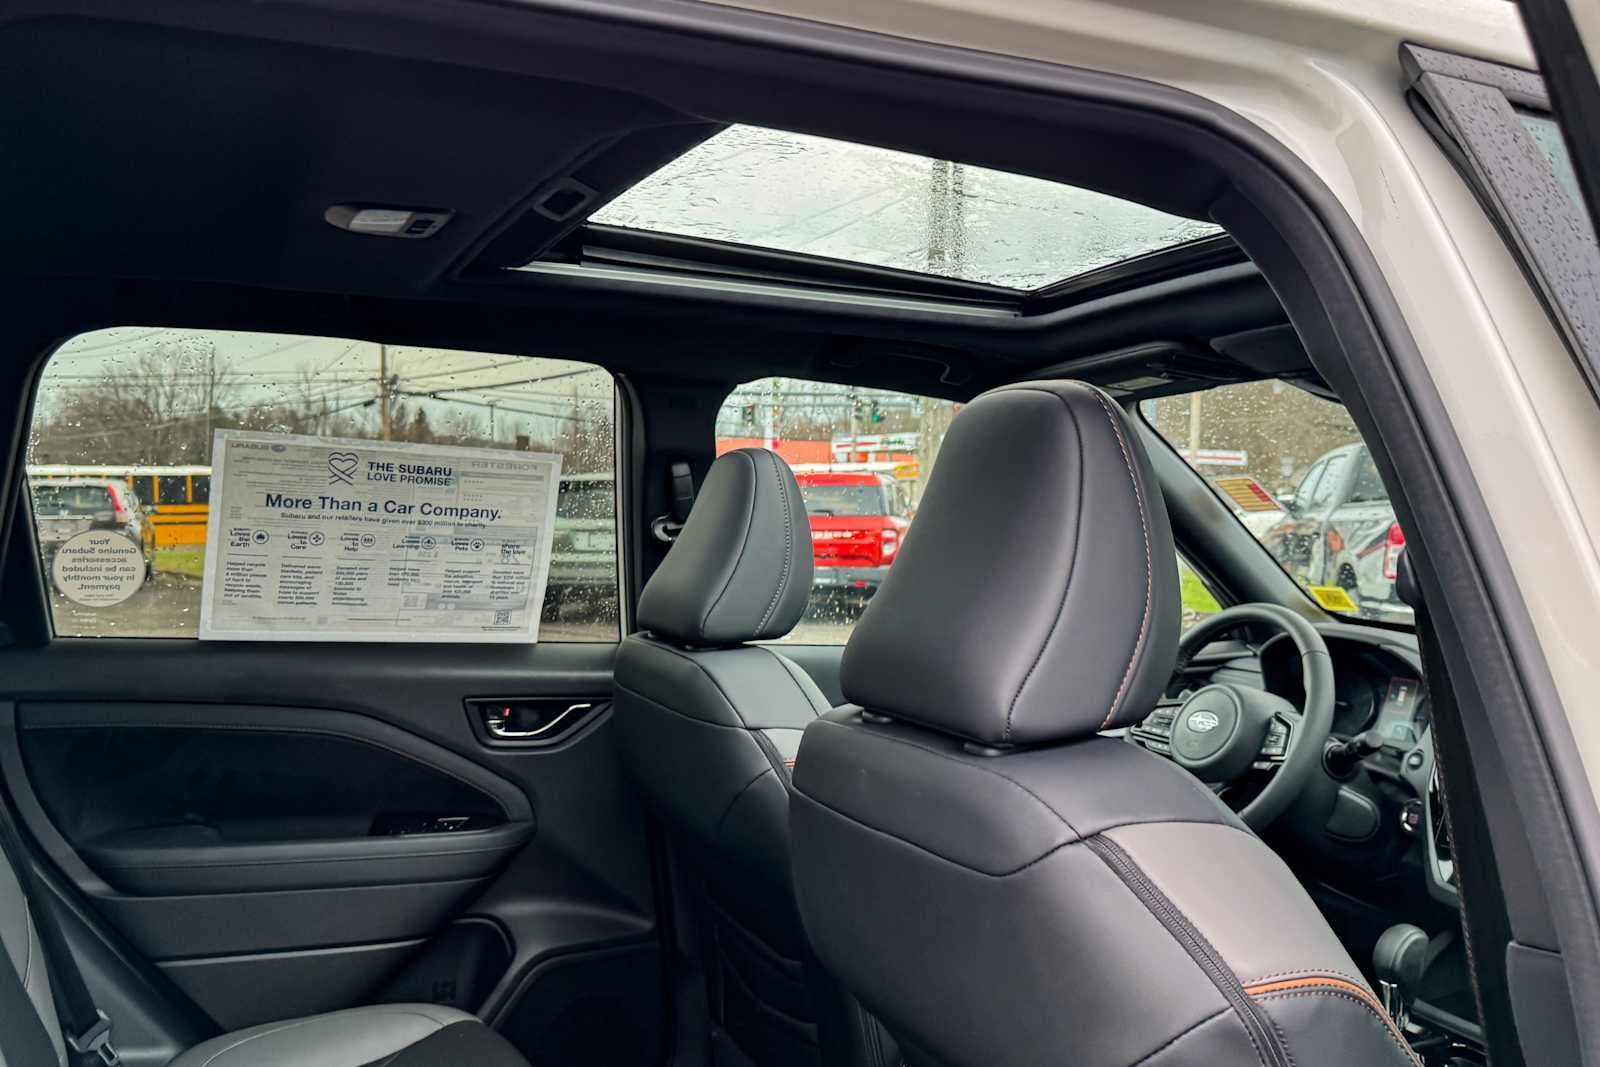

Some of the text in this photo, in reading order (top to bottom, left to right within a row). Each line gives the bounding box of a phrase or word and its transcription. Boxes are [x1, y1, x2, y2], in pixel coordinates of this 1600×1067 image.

[367, 461, 453, 477] THE SUBARU
[367, 473, 397, 483] LOVE
[266, 494, 312, 510] More
[320, 496, 363, 513] Than
[367, 501, 378, 513] a
[383, 500, 416, 515] Car
